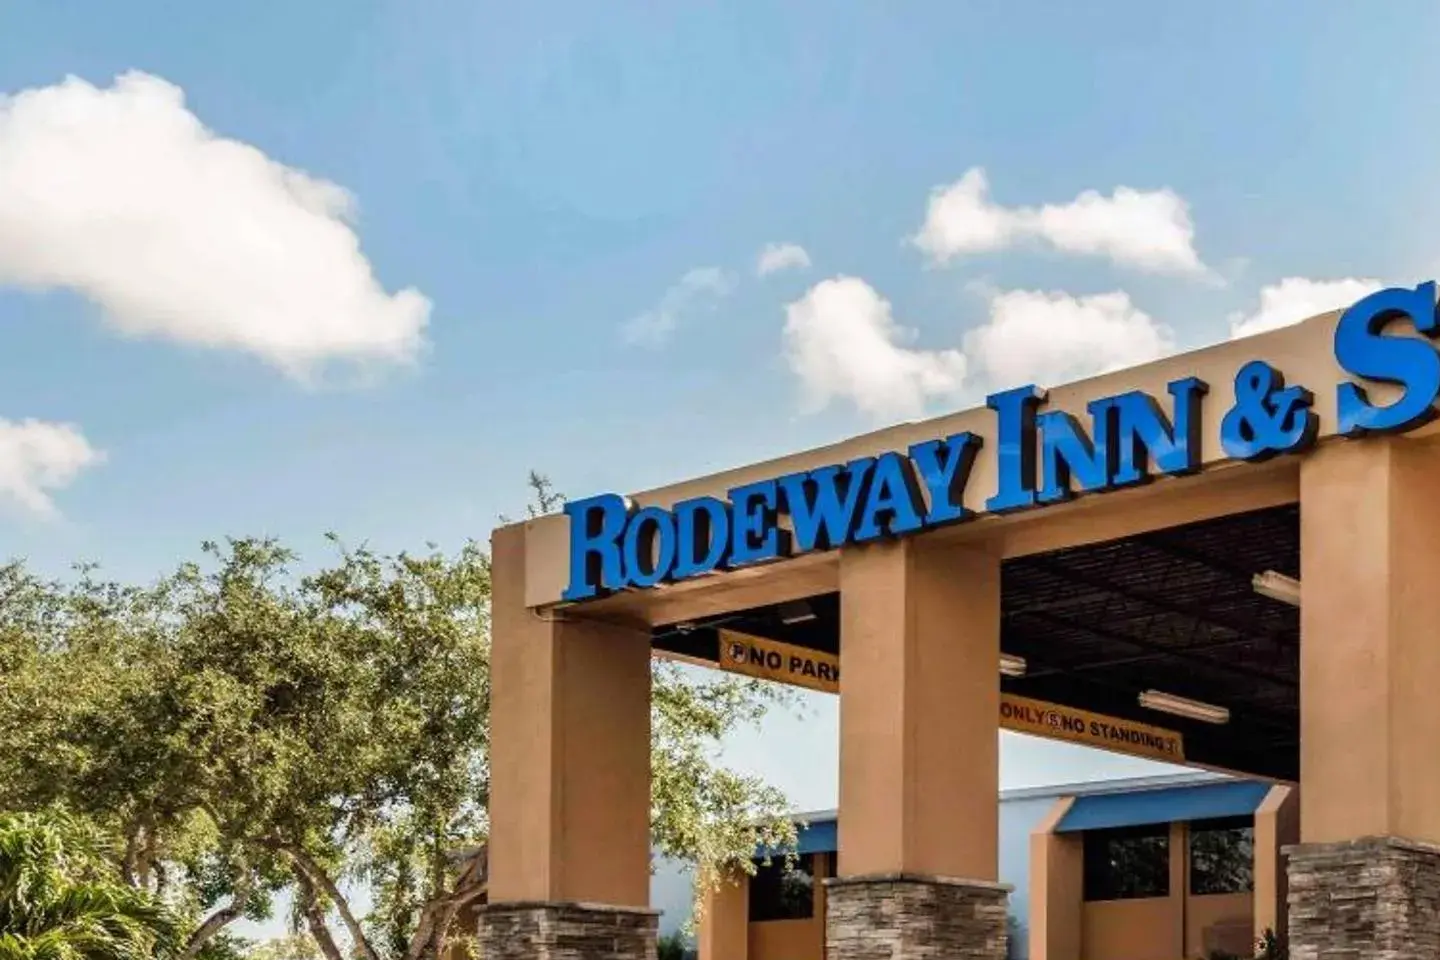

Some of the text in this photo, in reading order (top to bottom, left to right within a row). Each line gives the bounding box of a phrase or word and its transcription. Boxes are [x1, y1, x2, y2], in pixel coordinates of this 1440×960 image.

[562, 432, 982, 601] RODEWAY
[986, 384, 1208, 514] INN
[1221, 361, 1314, 460] &
[750, 647, 782, 669] NO
[1000, 703, 1164, 750] ONLY NO STANDING
